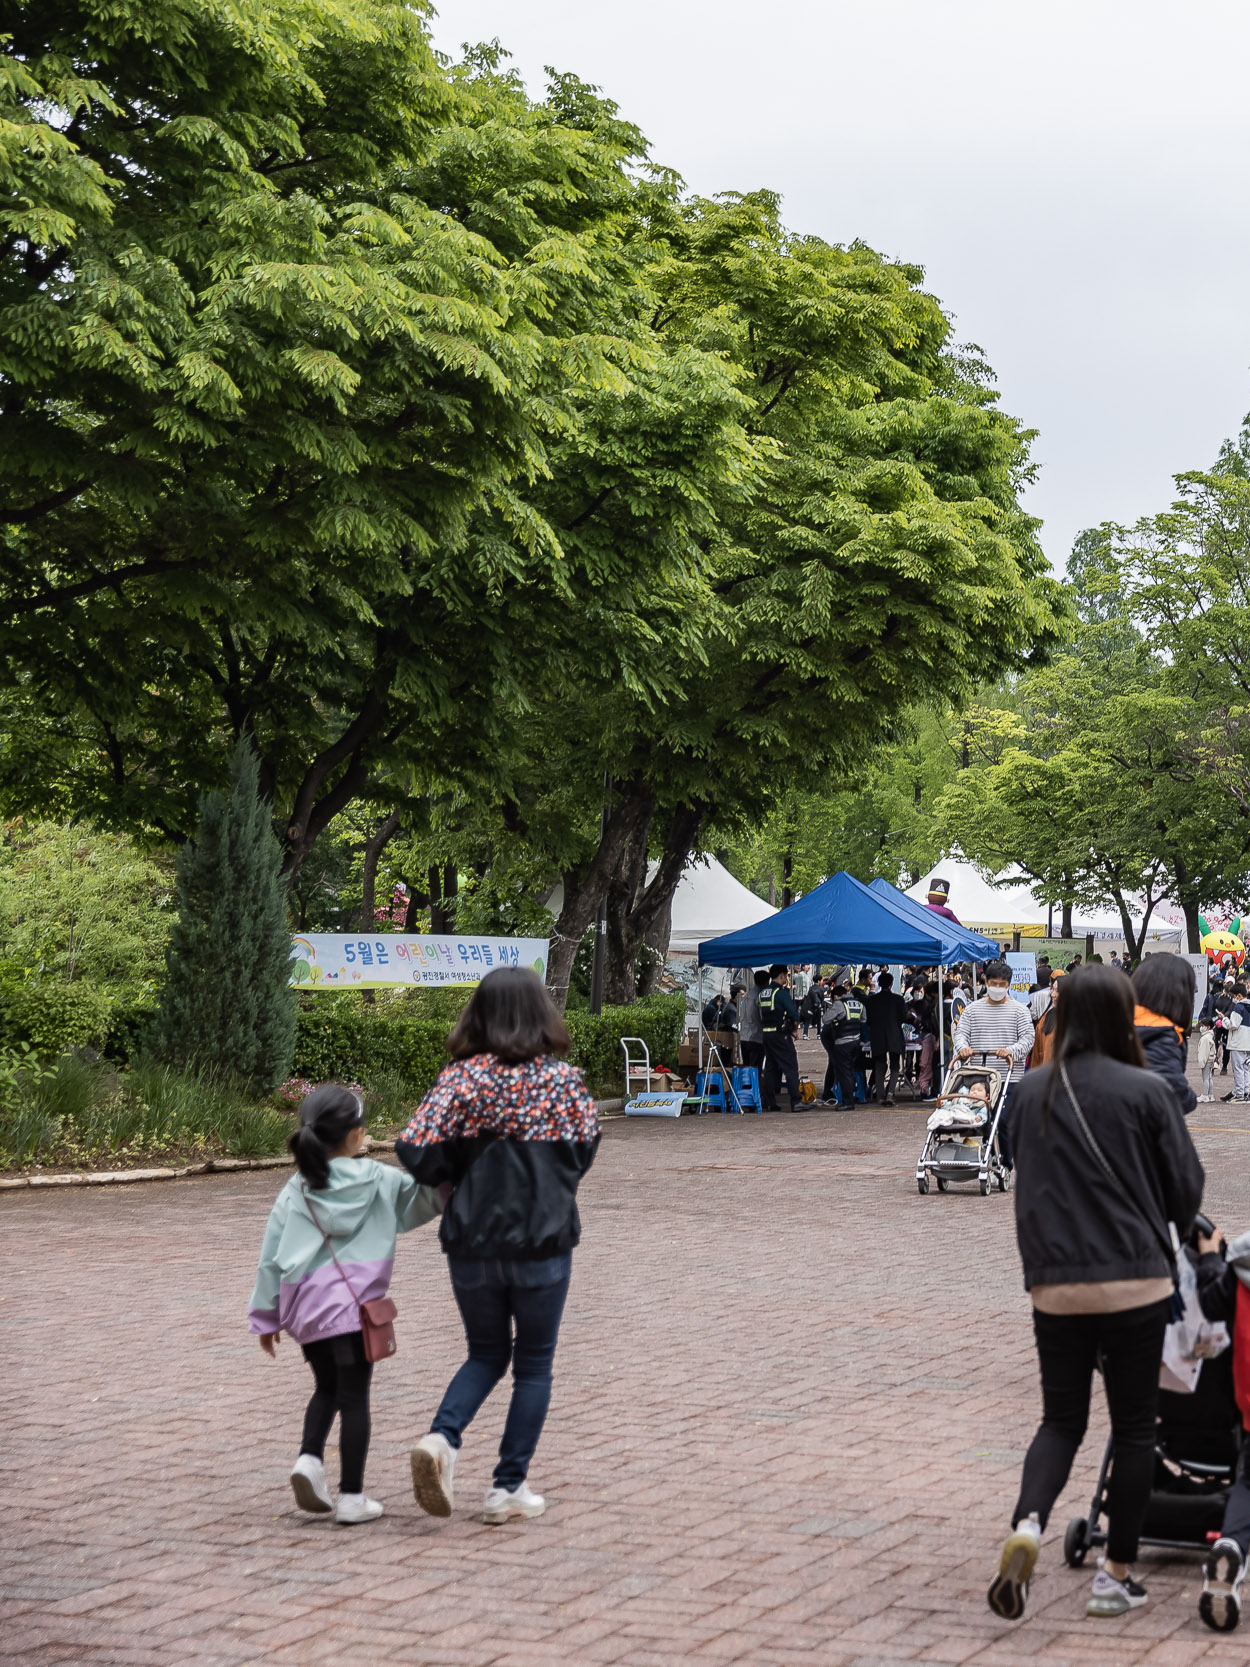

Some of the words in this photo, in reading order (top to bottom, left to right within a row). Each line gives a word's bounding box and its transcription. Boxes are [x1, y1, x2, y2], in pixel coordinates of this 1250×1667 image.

[344, 941, 389, 966] 5월은
[395, 943, 454, 966] 어린이날
[457, 943, 494, 966] 우리들
[498, 945, 520, 969] 세상
[422, 971, 450, 981] 광진경찰서
